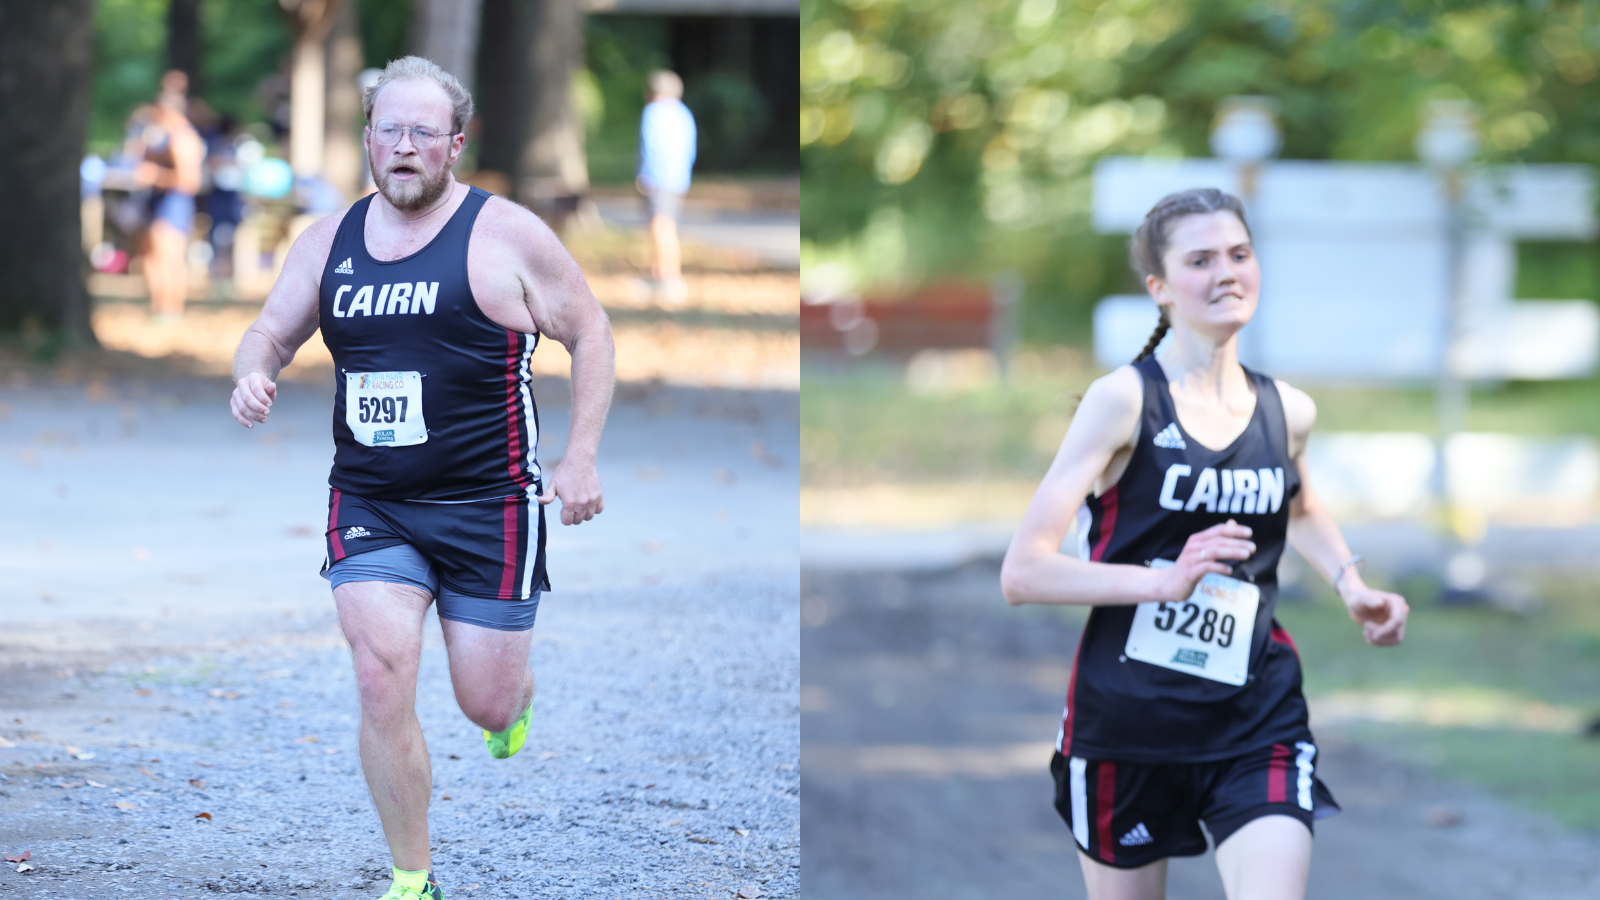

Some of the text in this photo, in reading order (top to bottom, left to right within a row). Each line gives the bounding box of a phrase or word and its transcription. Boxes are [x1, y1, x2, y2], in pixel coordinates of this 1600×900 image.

[334, 267, 354, 275] adidas
[333, 281, 440, 318] CAIRN
[371, 381, 404, 390] RACING CO
[358, 396, 408, 423] 5297
[1158, 463, 1285, 515] CAIRN
[1154, 600, 1236, 648] 5289
